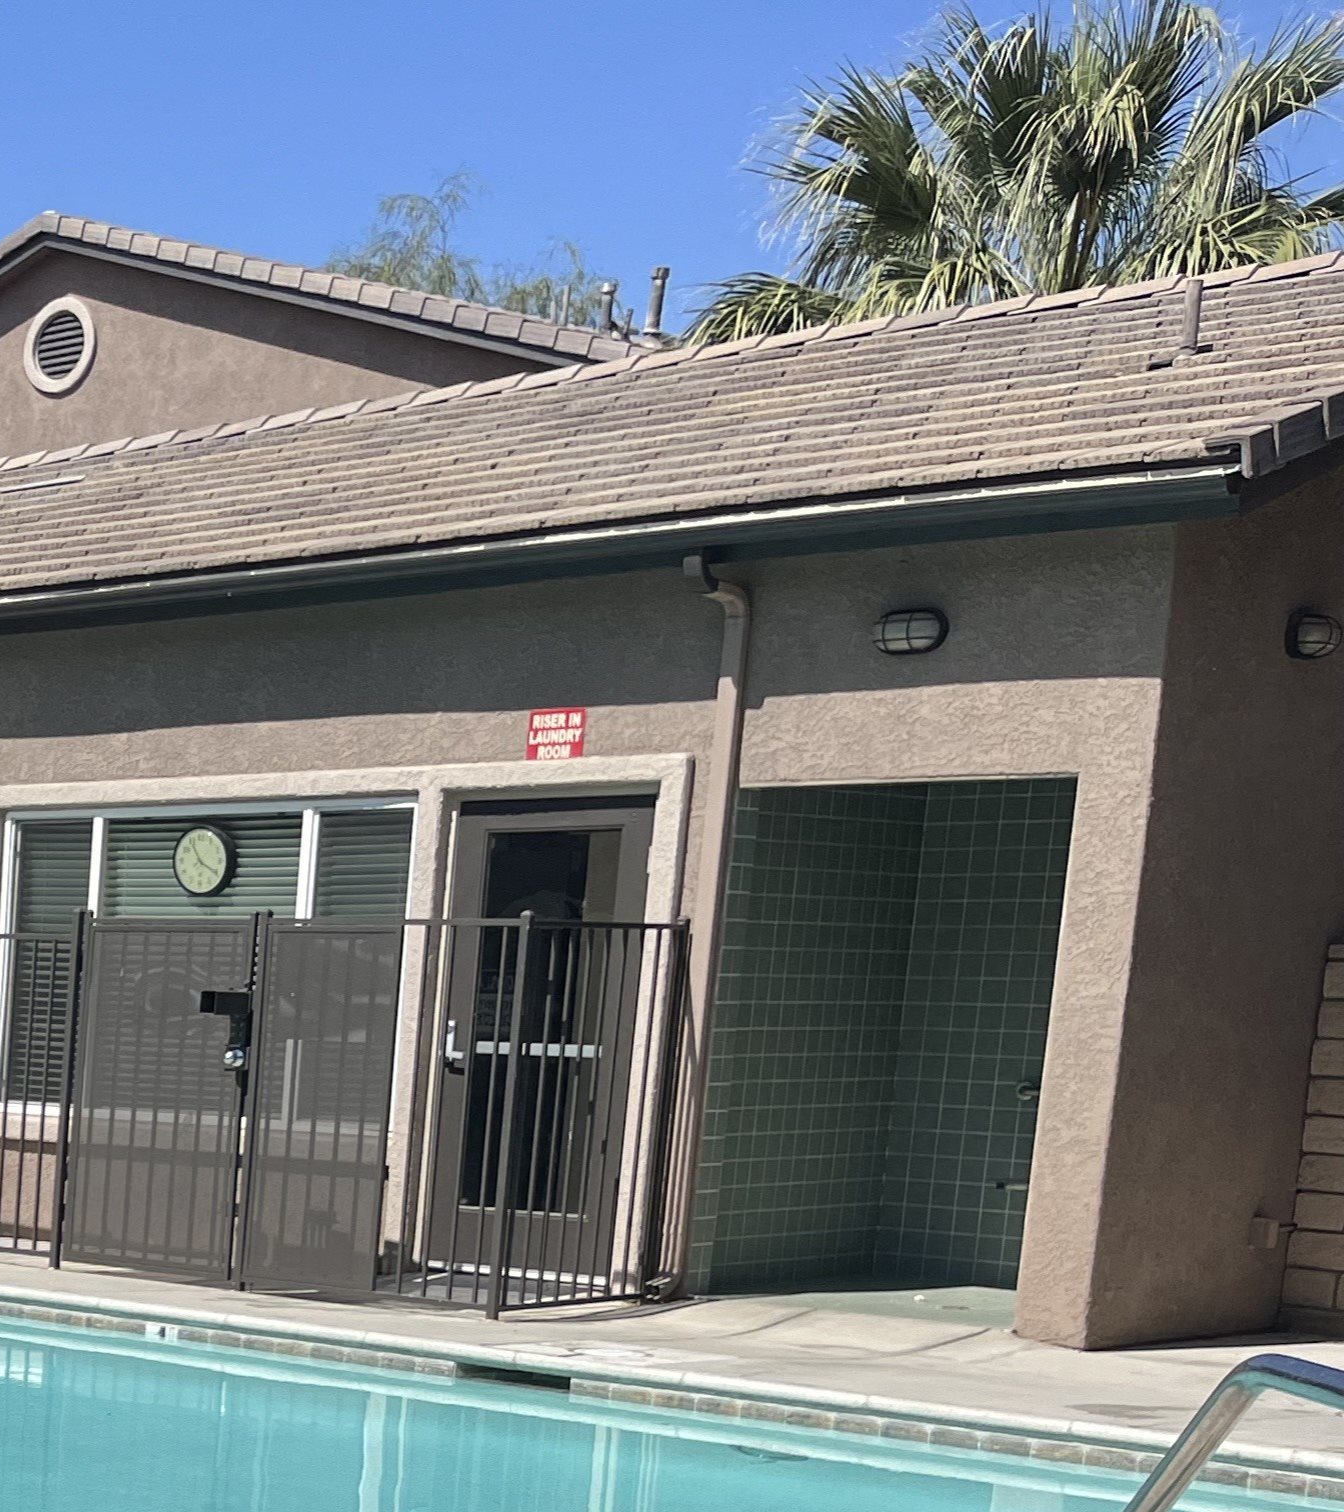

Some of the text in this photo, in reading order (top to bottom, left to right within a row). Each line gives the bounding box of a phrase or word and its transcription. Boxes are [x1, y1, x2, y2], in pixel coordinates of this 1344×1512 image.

[532, 712, 582, 729] RISER IN
[528, 728, 583, 745] LAUNDRY
[536, 744, 571, 760] ROOM
